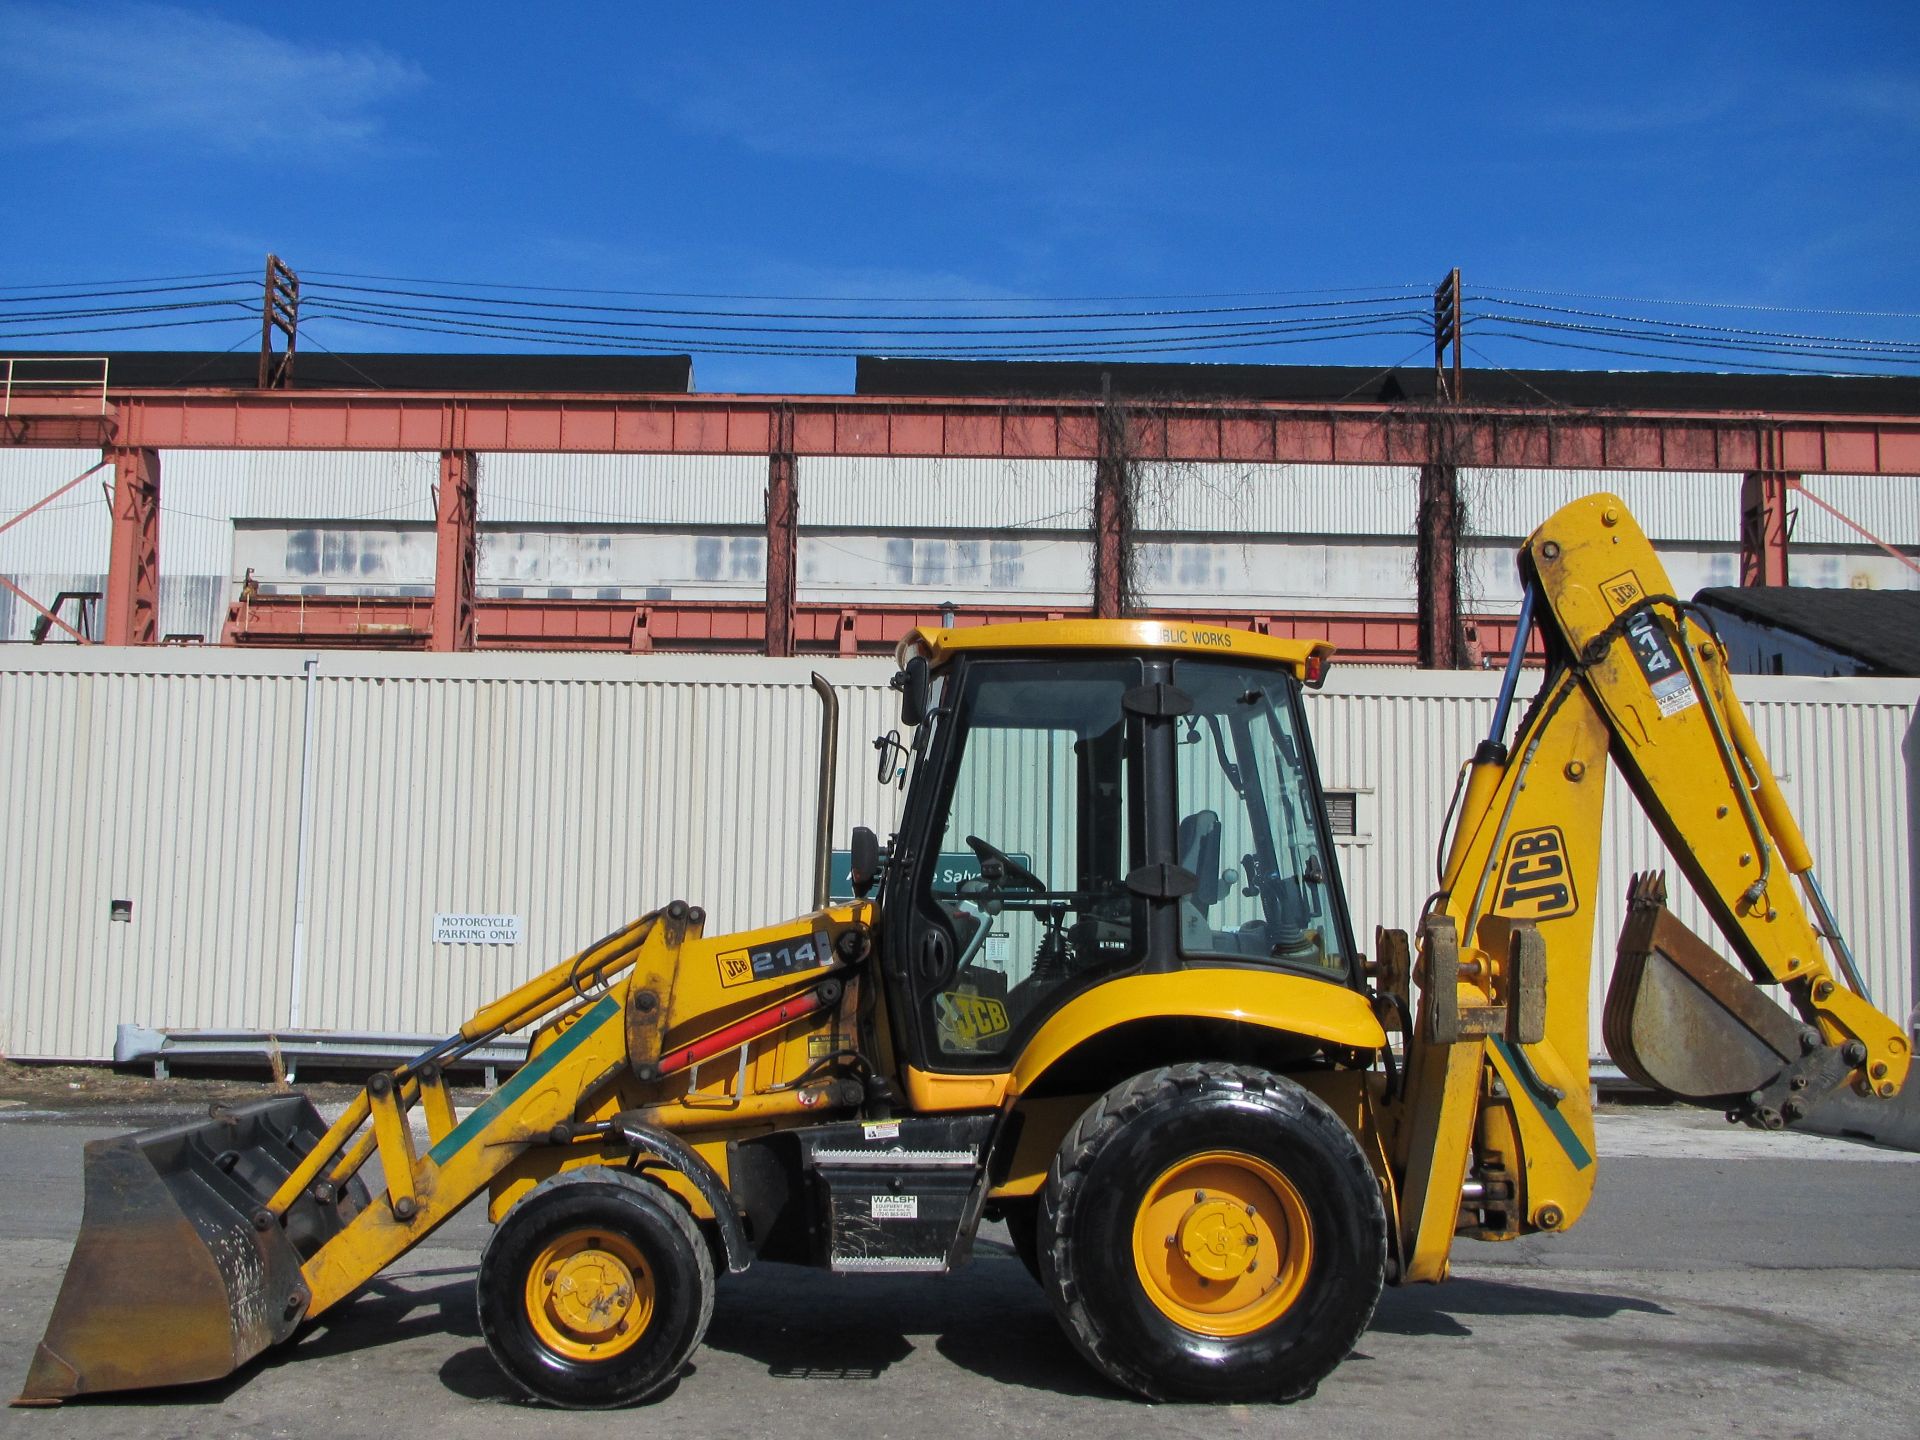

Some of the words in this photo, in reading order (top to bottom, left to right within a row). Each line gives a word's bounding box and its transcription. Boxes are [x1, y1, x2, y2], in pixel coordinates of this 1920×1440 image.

[1611, 584, 1636, 604] JCB
[1191, 630, 1232, 648] WORKS
[1625, 611, 1671, 672] 214
[1657, 686, 1692, 705] WALSH
[1500, 832, 1569, 912] JCB
[442, 917, 514, 928] MOTORCYCLE
[438, 929, 486, 939] PARKING
[489, 930, 518, 940] ONLY
[727, 960, 748, 977] JCB
[751, 943, 817, 973] 214
[955, 997, 1006, 1038] JCB
[873, 1196, 916, 1204] WALSH
